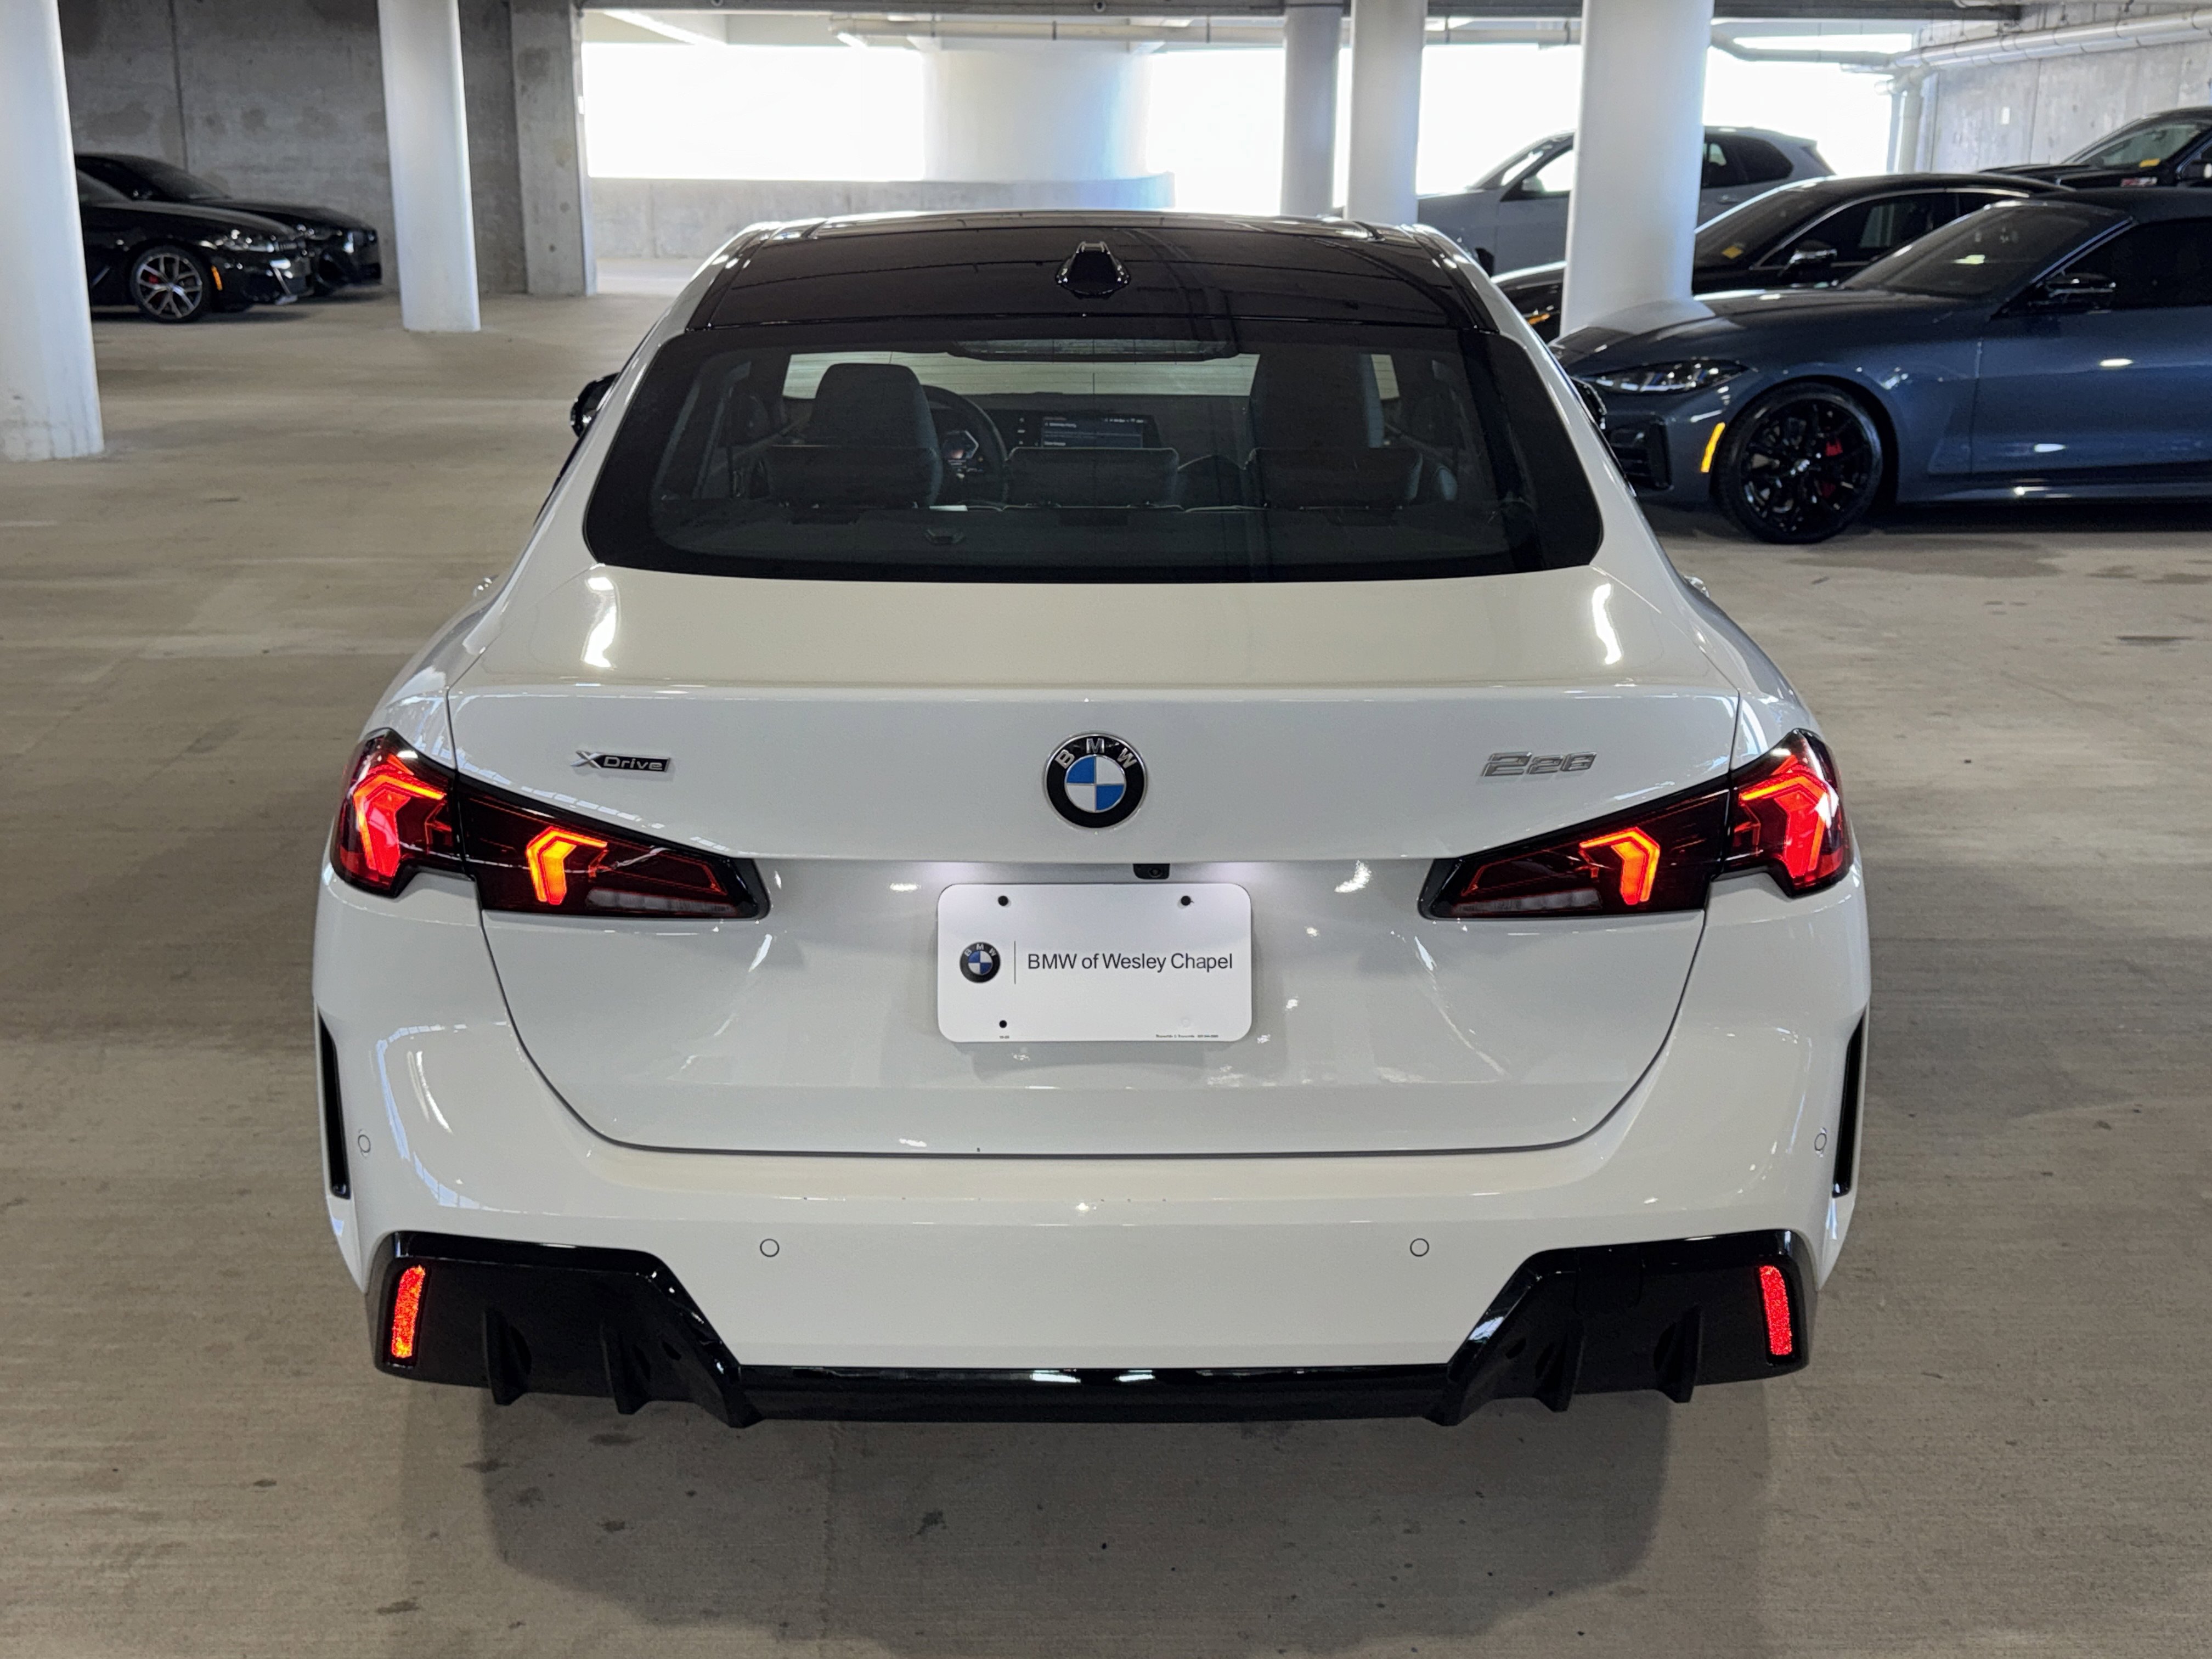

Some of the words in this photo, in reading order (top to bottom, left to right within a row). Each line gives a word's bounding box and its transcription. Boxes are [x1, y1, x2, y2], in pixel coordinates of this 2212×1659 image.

[1055, 737, 1137, 769] BMW
[964, 943, 997, 957] BMW
[1028, 953, 1077, 969] BMW
[1081, 953, 1099, 969] of
[1102, 952, 1166, 973] Wesley
[1171, 952, 1233, 973] Chapel
